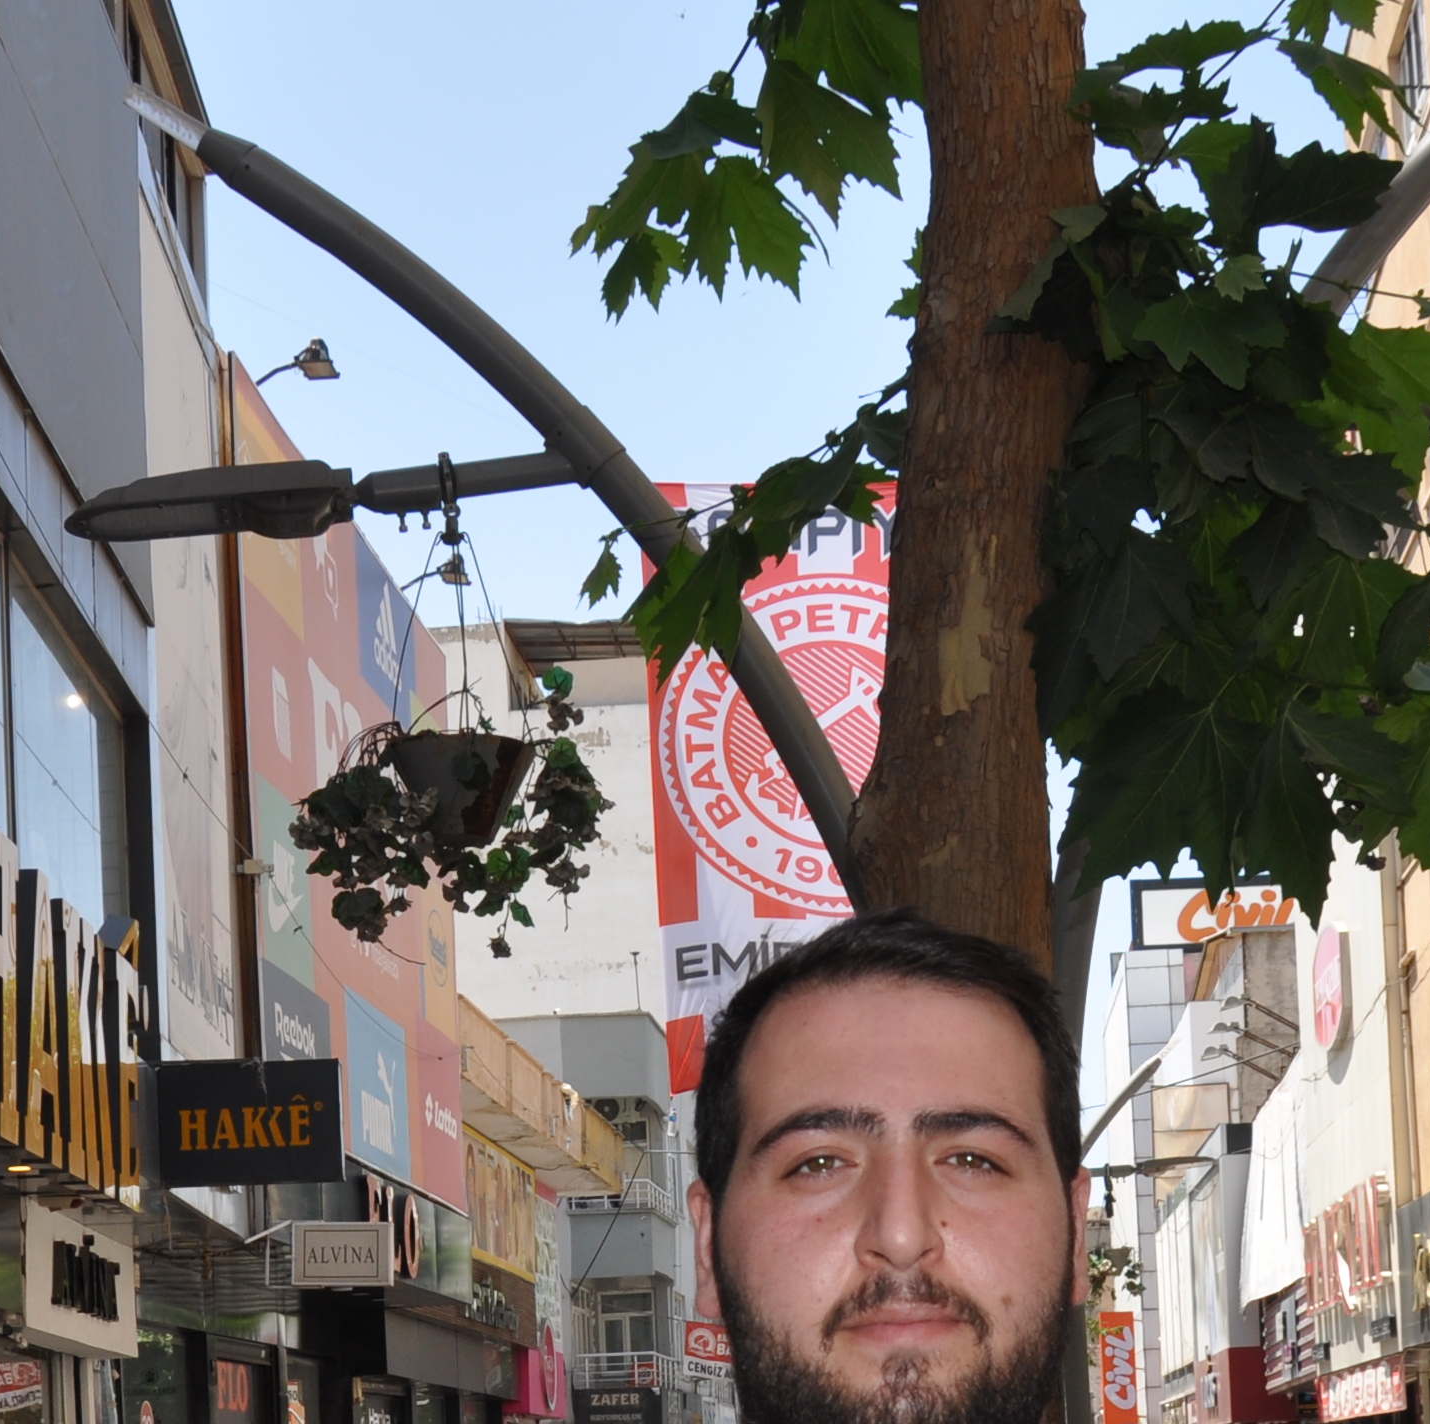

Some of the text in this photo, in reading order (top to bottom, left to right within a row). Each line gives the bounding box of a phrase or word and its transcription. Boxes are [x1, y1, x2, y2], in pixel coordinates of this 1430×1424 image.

[684, 656, 737, 831] BATMA
[274, 1002, 316, 1060] Reebok
[307, 1244, 375, 1264] ALVİNA
[216, 1358, 250, 1412] FLO
[688, 1361, 722, 1378] CENGİZ
[590, 1393, 640, 1406] ZAFER
